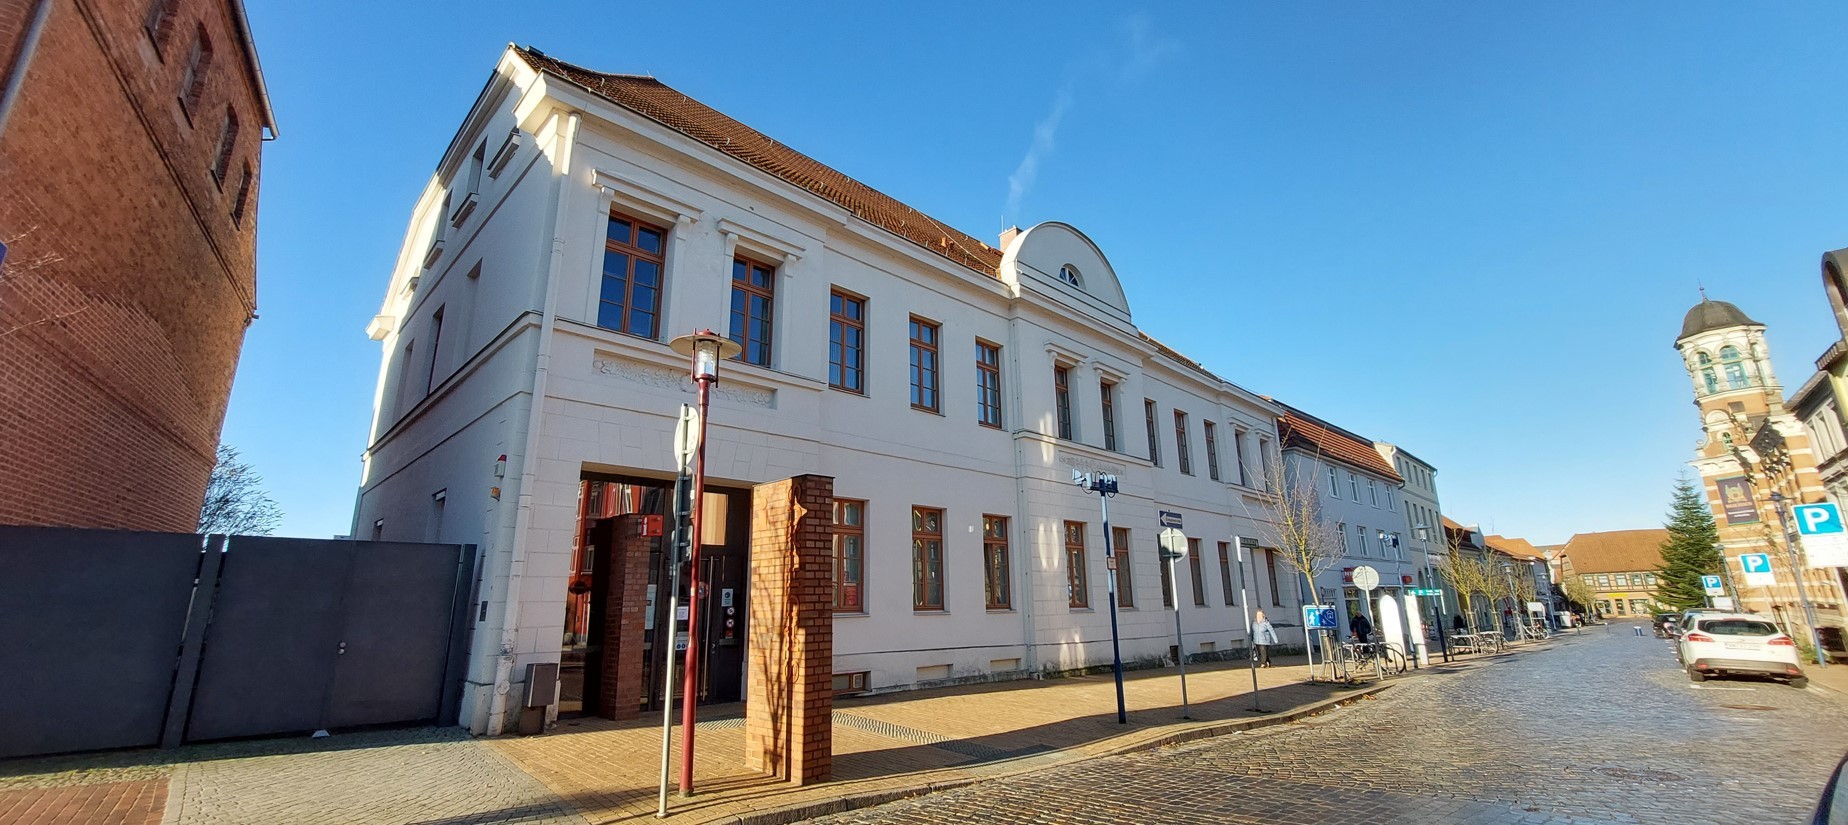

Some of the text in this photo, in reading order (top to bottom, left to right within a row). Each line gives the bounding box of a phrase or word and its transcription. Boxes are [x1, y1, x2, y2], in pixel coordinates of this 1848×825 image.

[1803, 508, 1830, 532] P
[1745, 556, 1764, 572] P
[1705, 577, 1718, 588] P
